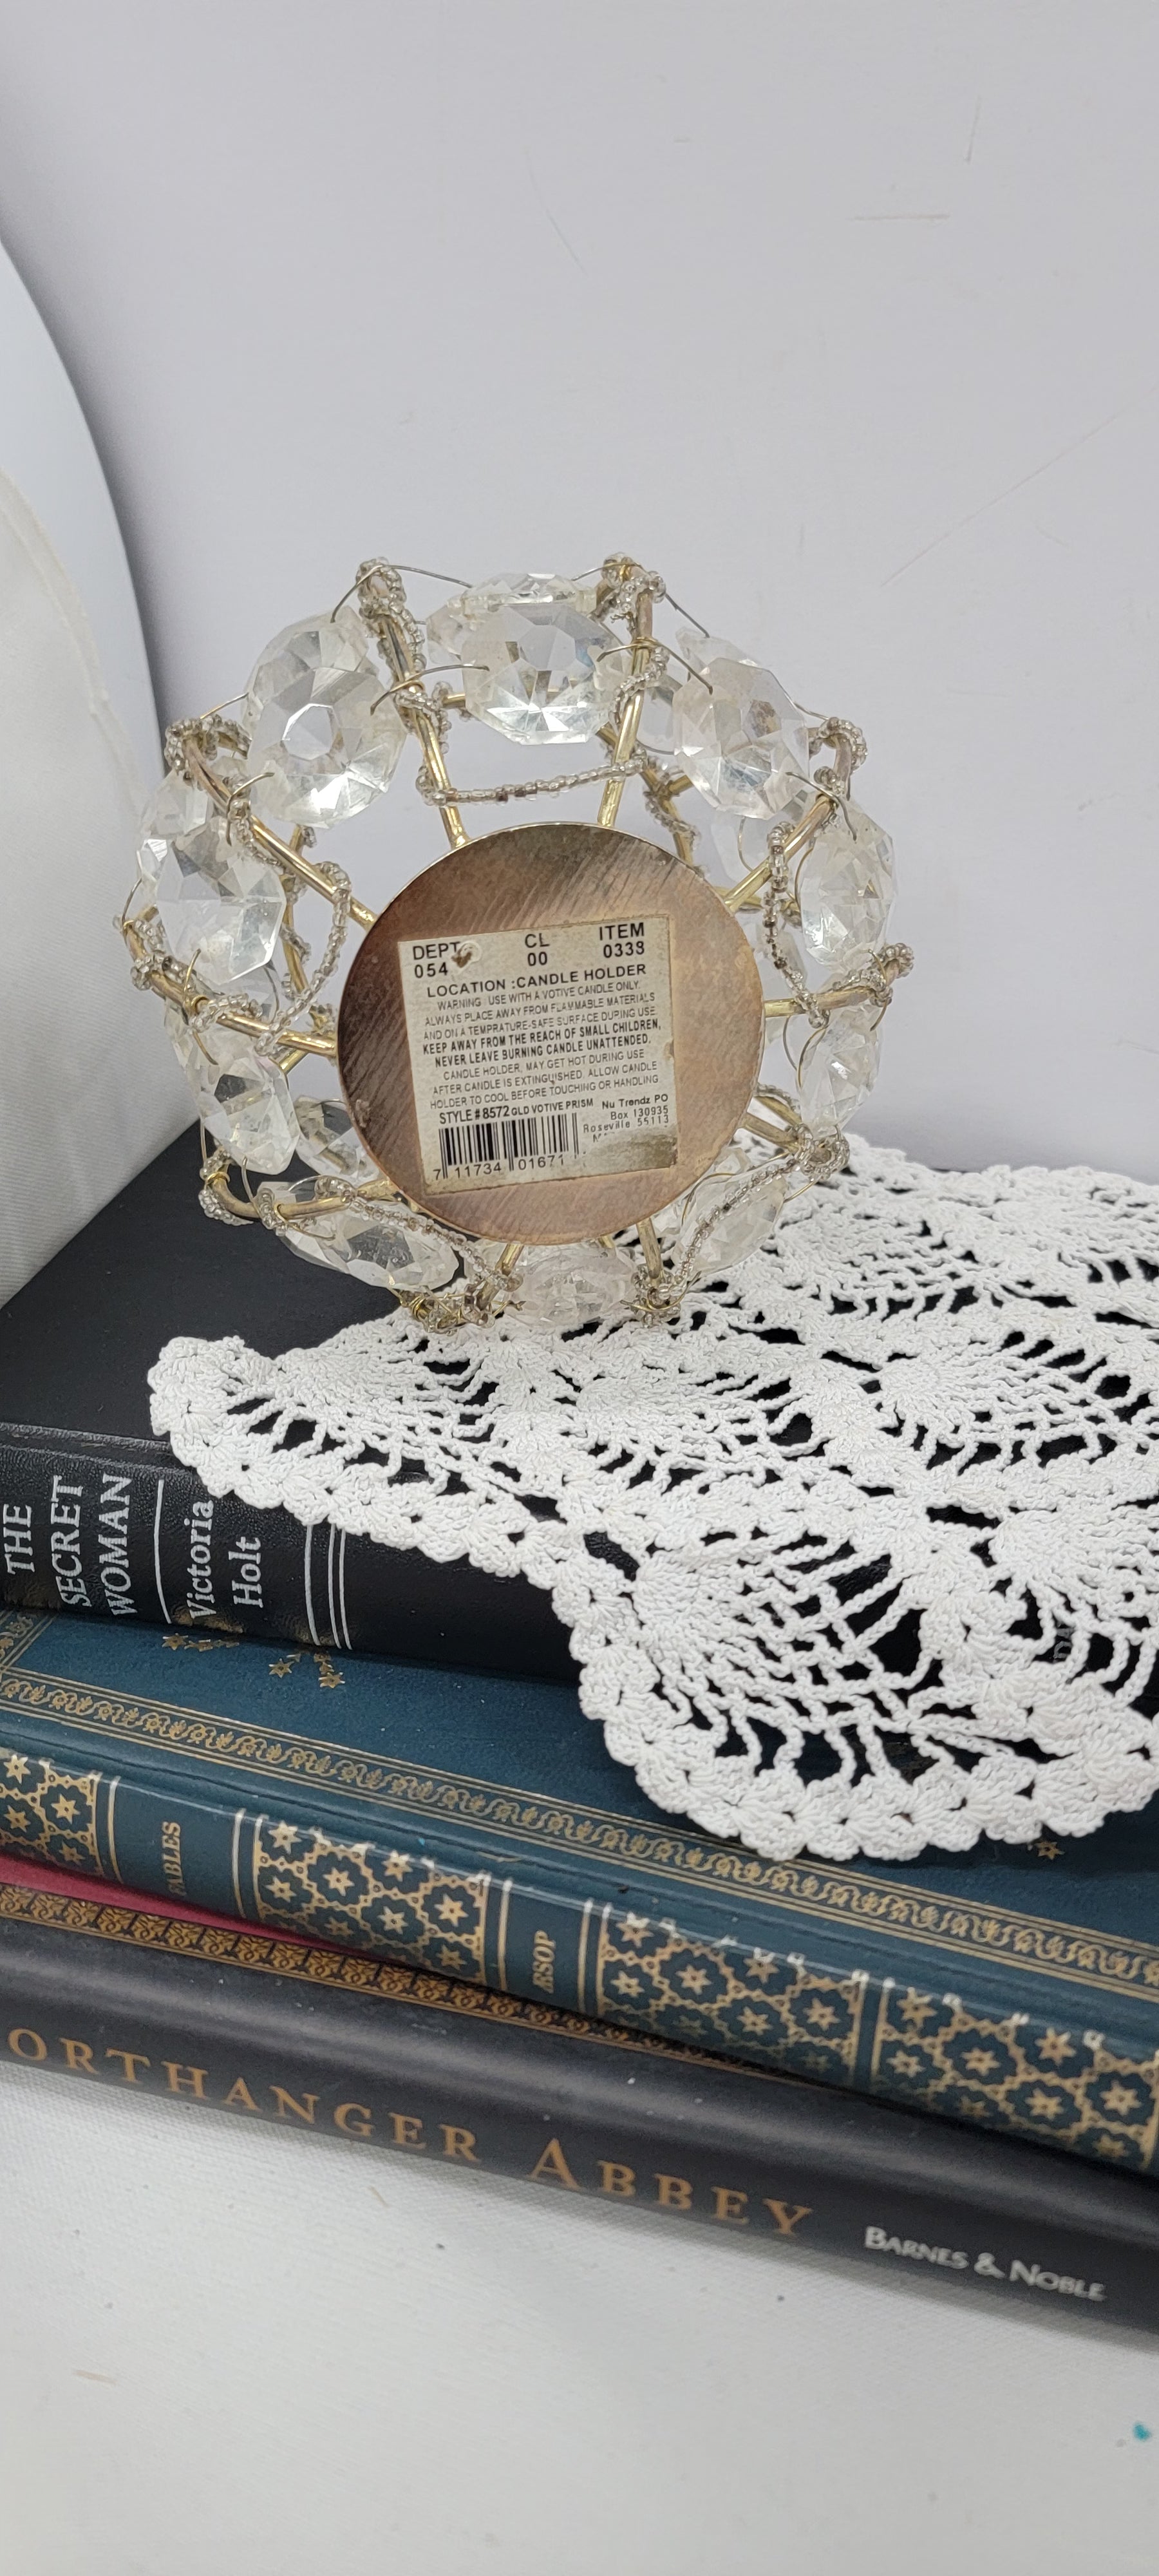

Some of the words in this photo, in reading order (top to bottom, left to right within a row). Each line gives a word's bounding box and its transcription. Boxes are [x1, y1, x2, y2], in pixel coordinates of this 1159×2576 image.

[525, 933, 550, 949] CL
[599, 922, 644, 941] ITEM
[415, 962, 448, 978] 054
[527, 951, 547, 967] 00
[428, 979, 505, 998] LOCATION
[584, 964, 646, 981] HOLDER
[425, 1014, 462, 1027] ALWAYS
[464, 1010, 493, 1023] PLACE
[496, 1007, 522, 1019] AWAY
[523, 1004, 549, 1016] FROM
[551, 998, 604, 1013] FLAMMABLE
[607, 992, 655, 1006] MATERIALS
[488, 994, 507, 1005] USE
[509, 992, 532, 1003] WITH
[534, 991, 540, 1000] A
[542, 987, 575, 999] VOTIVE
[578, 982, 614, 995] CANDLE
[422, 1042, 447, 1055] KEEP
[451, 1039, 477, 1052] AWAY
[481, 1036, 506, 1049] FROM
[509, 1033, 527, 1046] THE
[530, 1030, 561, 1043] REACH
[564, 1028, 576, 1039] OF
[580, 1024, 610, 1037] SMALL
[612, 1018, 661, 1034] CHILDREN,
[424, 1030, 442, 1041] AND
[444, 1028, 458, 1038] ON
[460, 1027, 466, 1036] A
[557, 1012, 599, 1027] SURFACE
[601, 1009, 636, 1021] DURING
[435, 1054, 467, 1068] NEVER
[469, 1050, 499, 1063] LEAVE
[502, 1045, 543, 1060] BURNING
[546, 1041, 583, 1055] CANDLE
[587, 1033, 652, 1050] UNATTENDED.
[443, 1067, 480, 1081] CANDLE
[526, 1061, 545, 1071] MAY
[547, 1058, 565, 1068] GET
[568, 1055, 587, 1066] HOT
[589, 1051, 624, 1064] DURING
[627, 1048, 645, 1059] USE
[430, 1097, 467, 1110] HOLDER
[469, 1095, 482, 1105] TO
[484, 1092, 509, 1103] COOL
[511, 1087, 547, 1101] BEFORE
[549, 1081, 596, 1095] TOUCHING
[598, 1079, 612, 1090] OR
[614, 1074, 659, 1088] HANDLING
[433, 1084, 462, 1095] AFTER
[464, 1079, 501, 1092] CANDLE
[504, 1078, 513, 1088] IS
[588, 1066, 619, 1077] ALLOW
[622, 1061, 657, 1073] CANDLE
[439, 1109, 473, 1124] STYLE
[511, 1106, 530, 1117] GLD
[531, 1101, 563, 1114] VOTIVE
[565, 1098, 594, 1110] PRISM
[601, 1100, 615, 1110] Nu
[654, 1094, 668, 1103] PO
[610, 1111, 628, 1121] Box
[634, 1105, 669, 1118] 130935
[583, 1119, 630, 1133] Roseville
[637, 1114, 669, 1127] 55113
[433, 1168, 441, 1180] 7
[455, 1161, 502, 1179] 11734
[3, 1504, 35, 1575] THE
[50, 1475, 91, 1607] SECRET
[99, 1473, 138, 1616] WOMAN
[184, 1500, 218, 1619] Victoria
[228, 1536, 265, 1608] Holt
[162, 1821, 187, 1896] FABLES
[527, 2137, 814, 2236] ABBEY
[864, 2225, 969, 2270] BARNES
[973, 2251, 1006, 2279] &
[1009, 2259, 1108, 2302] NOBLE
